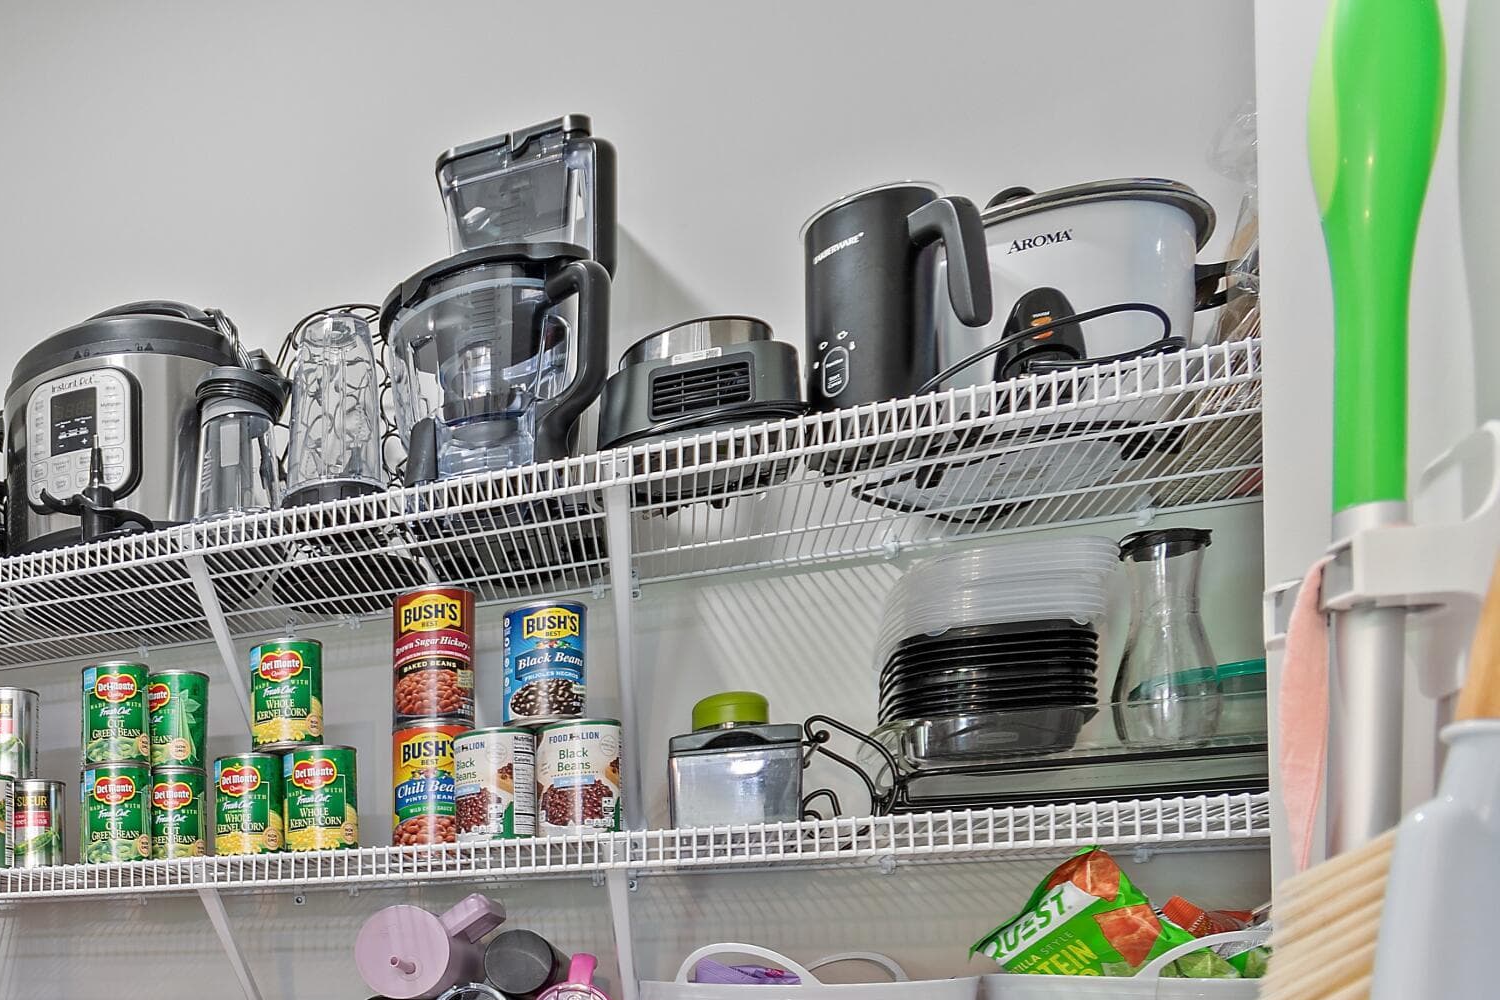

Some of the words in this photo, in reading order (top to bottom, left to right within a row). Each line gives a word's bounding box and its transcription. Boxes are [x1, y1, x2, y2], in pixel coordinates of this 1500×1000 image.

[1008, 230, 1073, 254] AROMA
[52, 380, 77, 393] Instant
[80, 376, 92, 384] Pot
[404, 603, 458, 627] BUSH'S
[526, 614, 578, 636] BUSH'S
[414, 638, 440, 648] Sugar
[440, 636, 469, 650] Hickory
[262, 660, 274, 672] Del
[274, 658, 300, 670] Monte
[404, 661, 428, 673] BAKED
[430, 660, 457, 668] BEANS
[518, 654, 552, 670] Black
[554, 650, 584, 667] Beans
[98, 683, 110, 692] Del
[110, 682, 134, 692] Monte
[266, 698, 295, 709] WHOLE
[284, 708, 308, 718] CORN
[118, 728, 141, 738] BEANS
[548, 734, 568, 744] FOOD
[581, 731, 600, 740] LION
[558, 748, 589, 760] Black
[557, 760, 592, 772] Beans
[294, 769, 306, 779] Del
[306, 767, 334, 777] Monte
[398, 781, 426, 799] Chili
[406, 795, 428, 804] PINTO
[318, 815, 342, 826] CORN
[985, 886, 1067, 961] QUEST
[1040, 930, 1074, 956] STYLE
